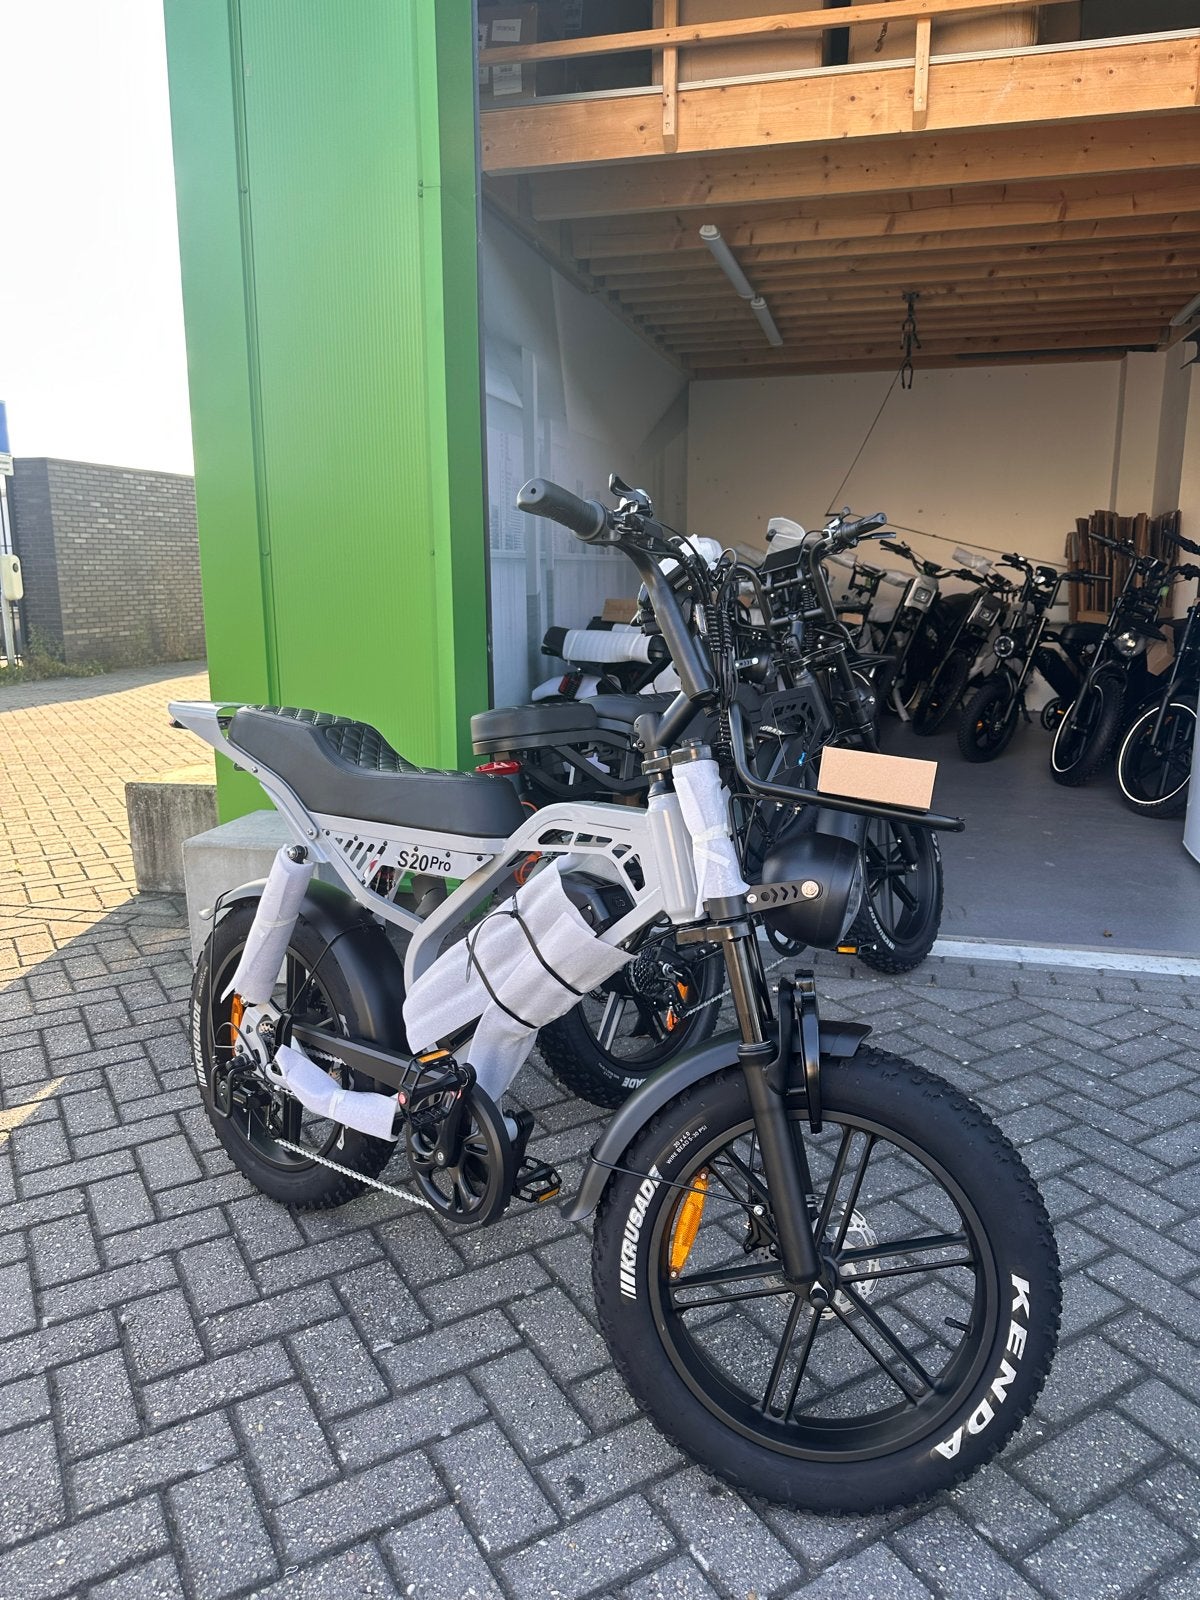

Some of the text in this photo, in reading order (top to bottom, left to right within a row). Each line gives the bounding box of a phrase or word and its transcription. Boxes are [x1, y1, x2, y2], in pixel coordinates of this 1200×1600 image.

[666, 1152, 678, 1164] WIRE
[676, 1140, 690, 1153] BEAD
[698, 1125, 707, 1133] PSI
[620, 1164, 664, 1280] KRUSADE
[934, 1273, 1030, 1460] KENDA
